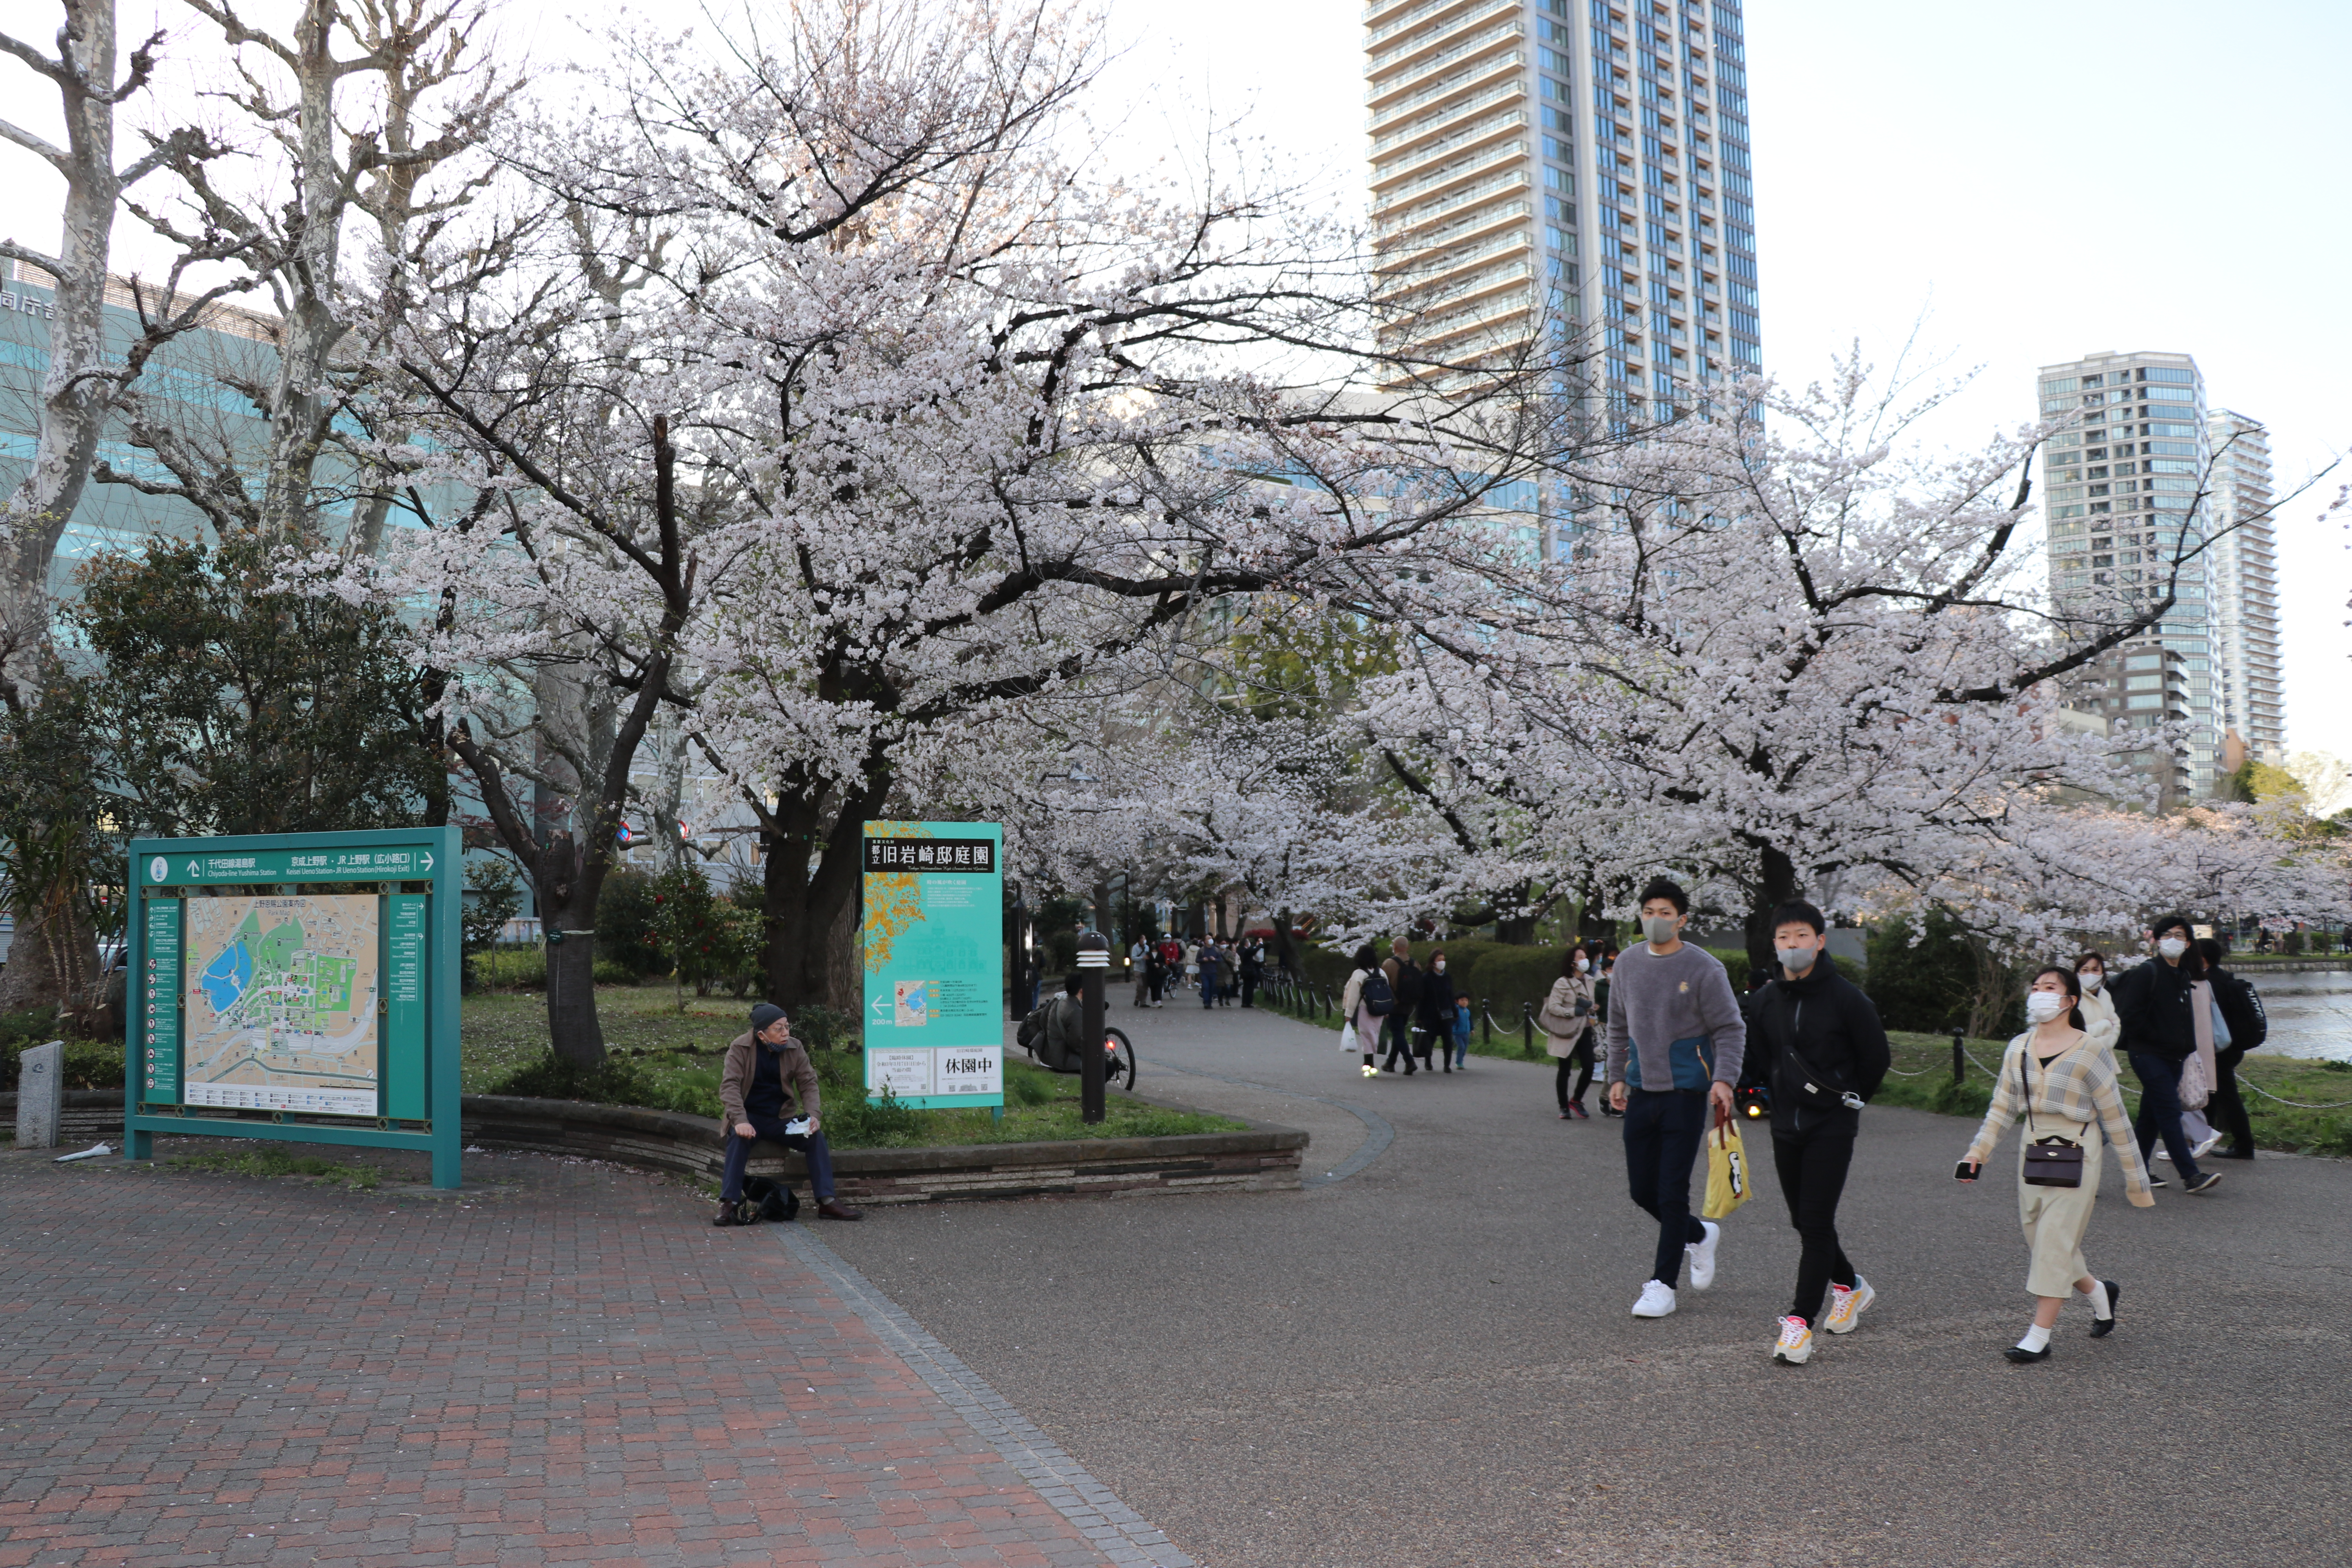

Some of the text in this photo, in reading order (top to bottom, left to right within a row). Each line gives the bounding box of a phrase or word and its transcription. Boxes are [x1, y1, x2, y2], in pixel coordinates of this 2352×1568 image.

[871, 845, 880, 864] 都立
[883, 845, 988, 864] 旧岩崎邸庭園
[208, 858, 256, 869] 千代田線湯島駅
[208, 870, 237, 878] Chiyoda-line
[254, 899, 306, 908] 上野恩賜公園案内図
[945, 1057, 992, 1074] 休園中
